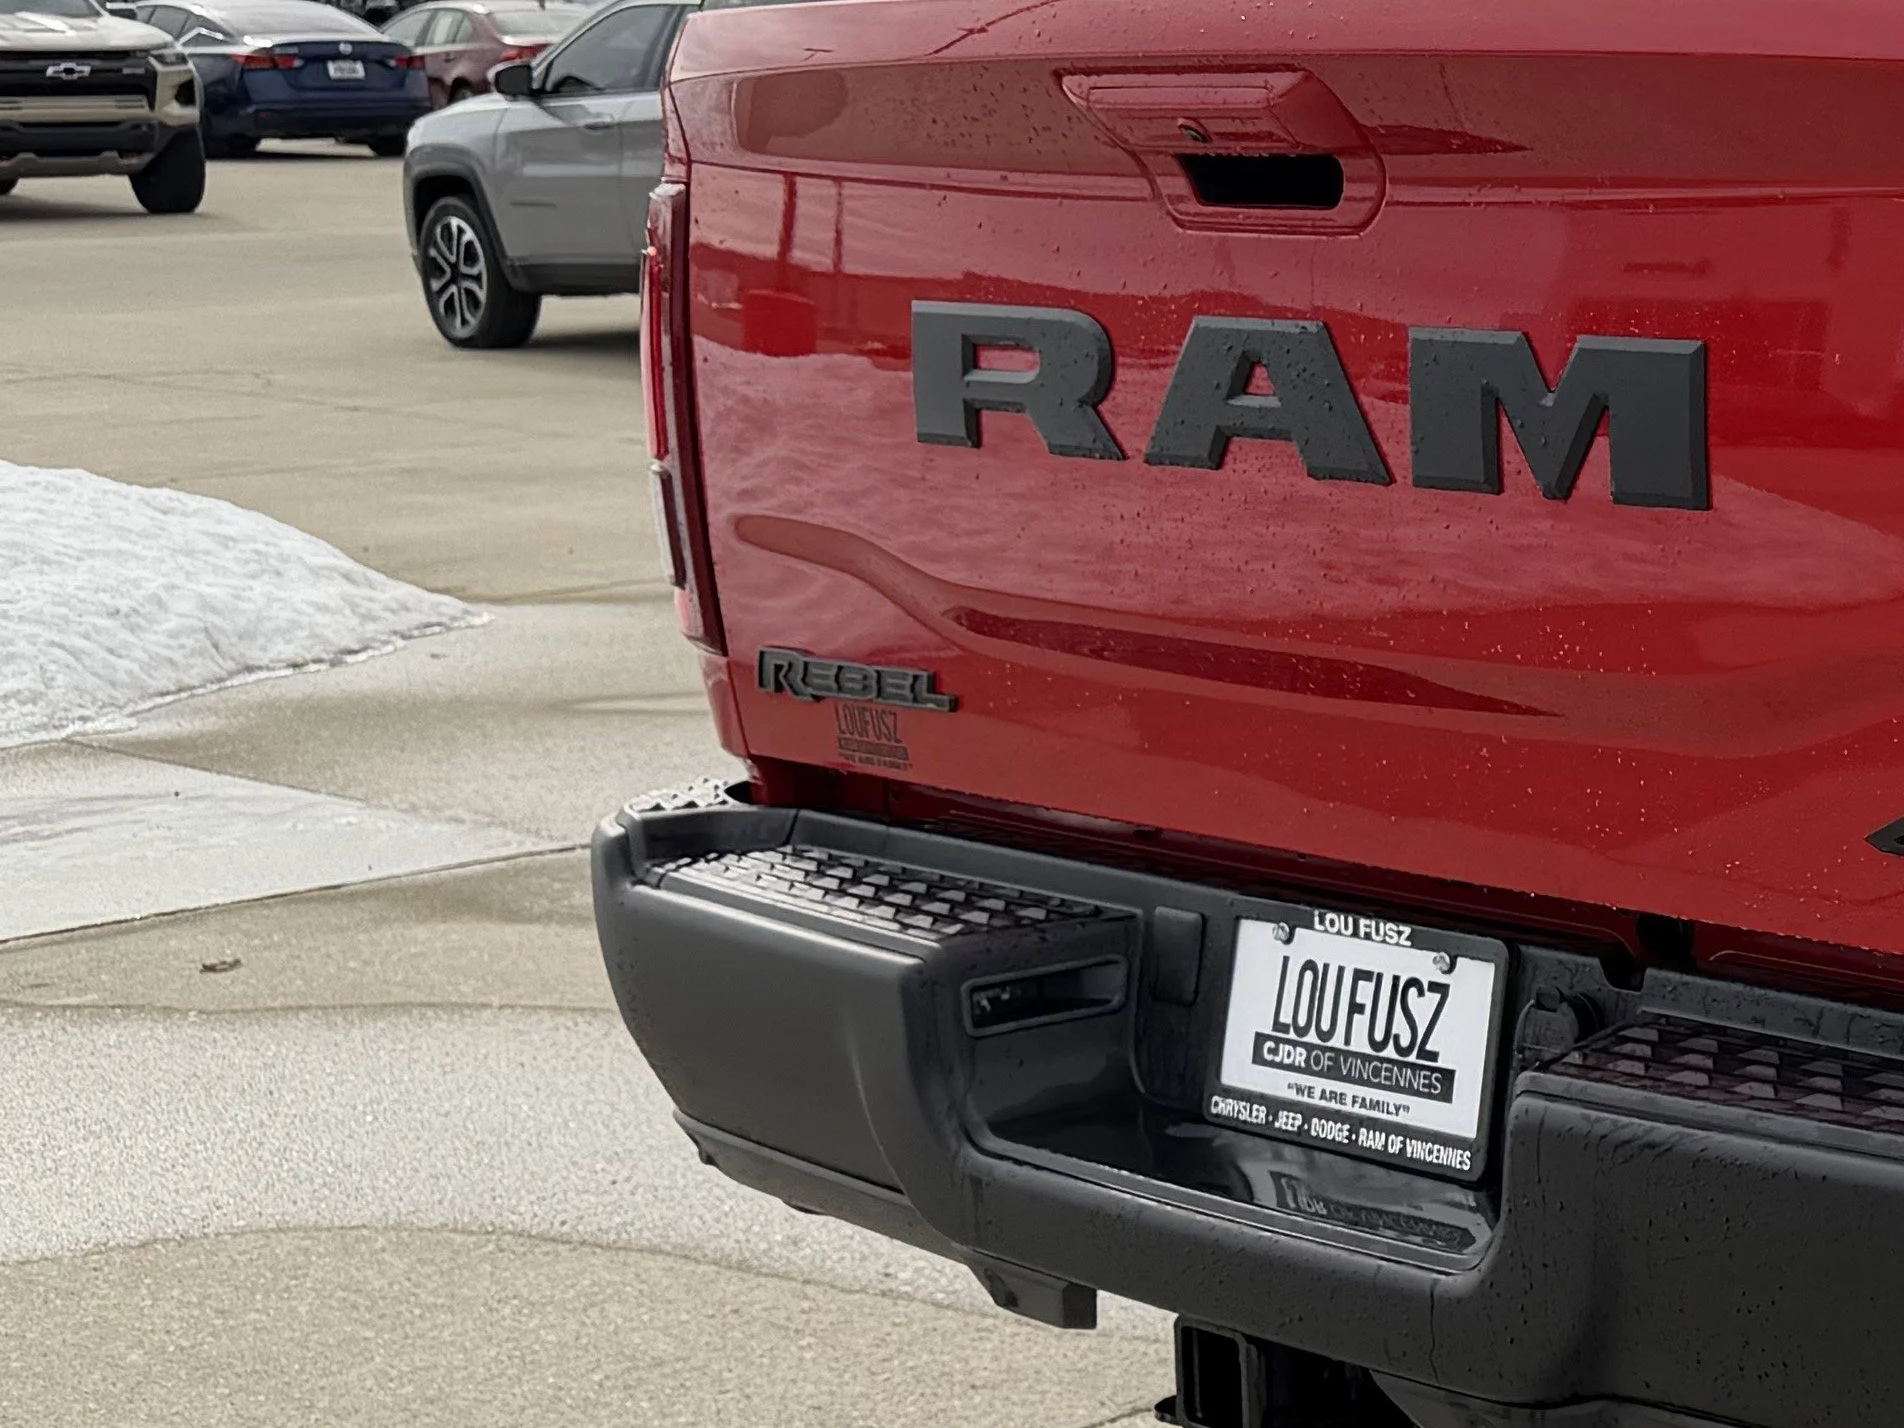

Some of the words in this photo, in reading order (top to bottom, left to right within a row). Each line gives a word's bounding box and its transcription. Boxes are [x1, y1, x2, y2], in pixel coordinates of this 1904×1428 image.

[911, 299, 1712, 512] RAM
[759, 647, 959, 712] REBEL
[1313, 910, 1353, 936] LOU
[1358, 919, 1413, 947] FUSZ
[1262, 1042, 1308, 1068] CJDR
[1309, 1049, 1336, 1072] OF
[1339, 1054, 1443, 1095] VINCENNES
[1318, 1086, 1348, 1106] ARE
[1209, 1094, 1268, 1125] CHRYSLER
[1273, 1109, 1303, 1132] JEEP
[1309, 1117, 1350, 1145] DODGE
[1357, 1127, 1386, 1152] RAM
[1387, 1133, 1405, 1156] OF
[1405, 1137, 1472, 1172] VINCENNES
